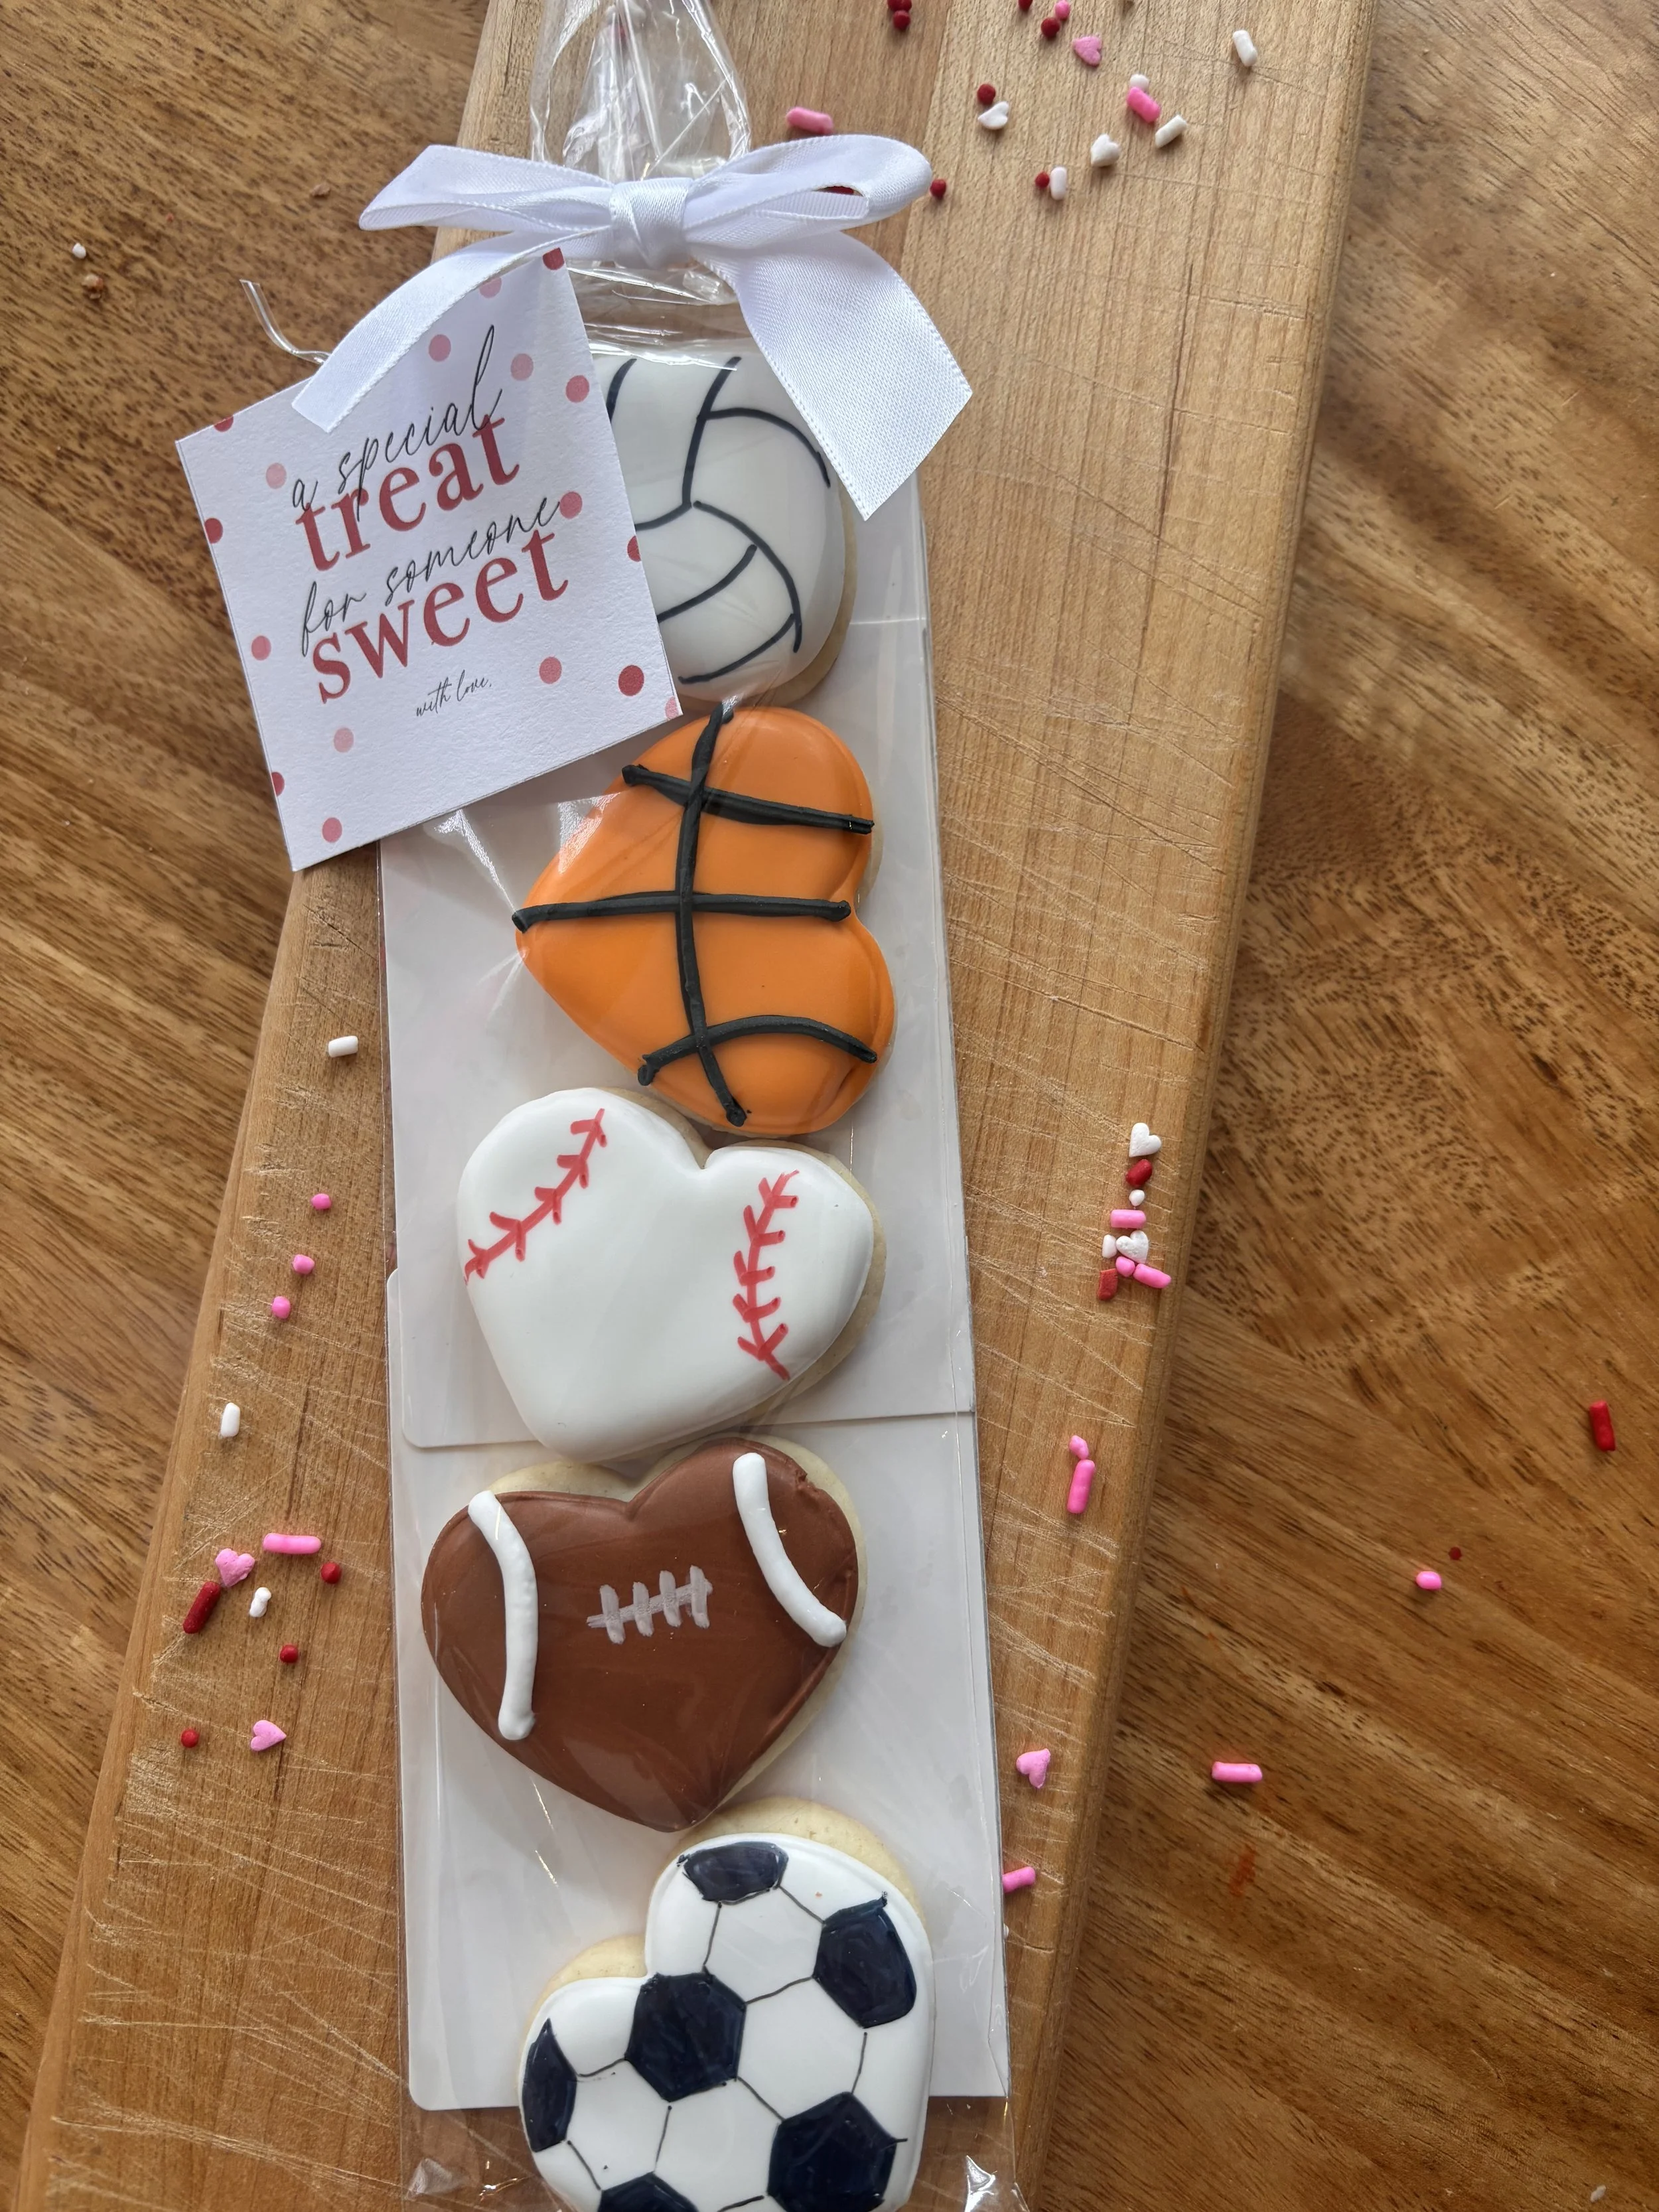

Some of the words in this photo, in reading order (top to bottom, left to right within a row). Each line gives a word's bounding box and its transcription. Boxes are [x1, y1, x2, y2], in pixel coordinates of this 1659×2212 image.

[292, 477, 319, 512] a
[337, 324, 503, 522] special
[295, 414, 520, 571] treat
[301, 581, 367, 657] for
[384, 496, 560, 606] someone
[313, 530, 569, 704] sweet
[415, 676, 453, 717] with
